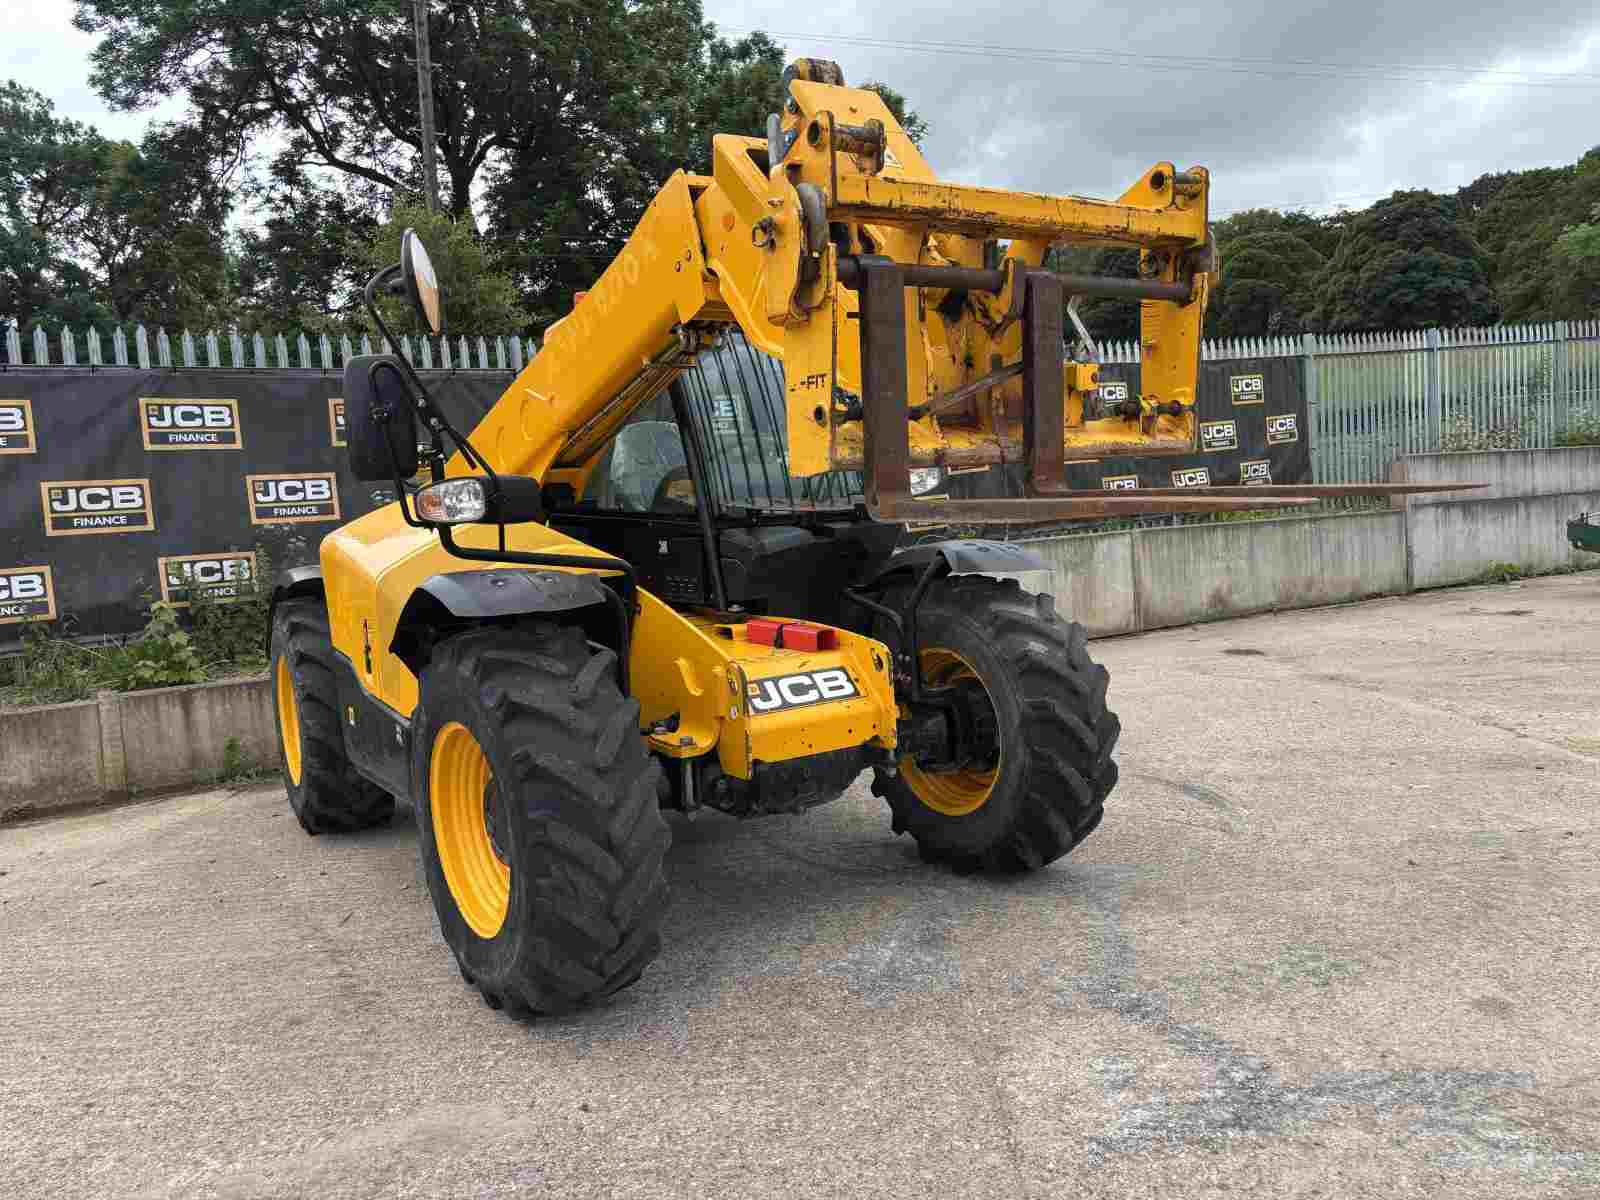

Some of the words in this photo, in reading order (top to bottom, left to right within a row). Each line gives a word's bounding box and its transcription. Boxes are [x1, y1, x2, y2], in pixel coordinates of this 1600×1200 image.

[789, 373, 827, 391] -FIT
[1233, 378, 1261, 392] JCB
[149, 405, 232, 428] JCB
[1203, 424, 1234, 440] JCB
[1269, 418, 1296, 433] JCB
[168, 433, 219, 443] FINANCE
[1244, 463, 1268, 478] JCB
[1176, 471, 1208, 487] JCB
[256, 479, 331, 502] JCB
[51, 486, 143, 512] JCB
[272, 505, 320, 516] FINANCE
[73, 515, 128, 527] FINANCE
[751, 669, 855, 711] JCB
